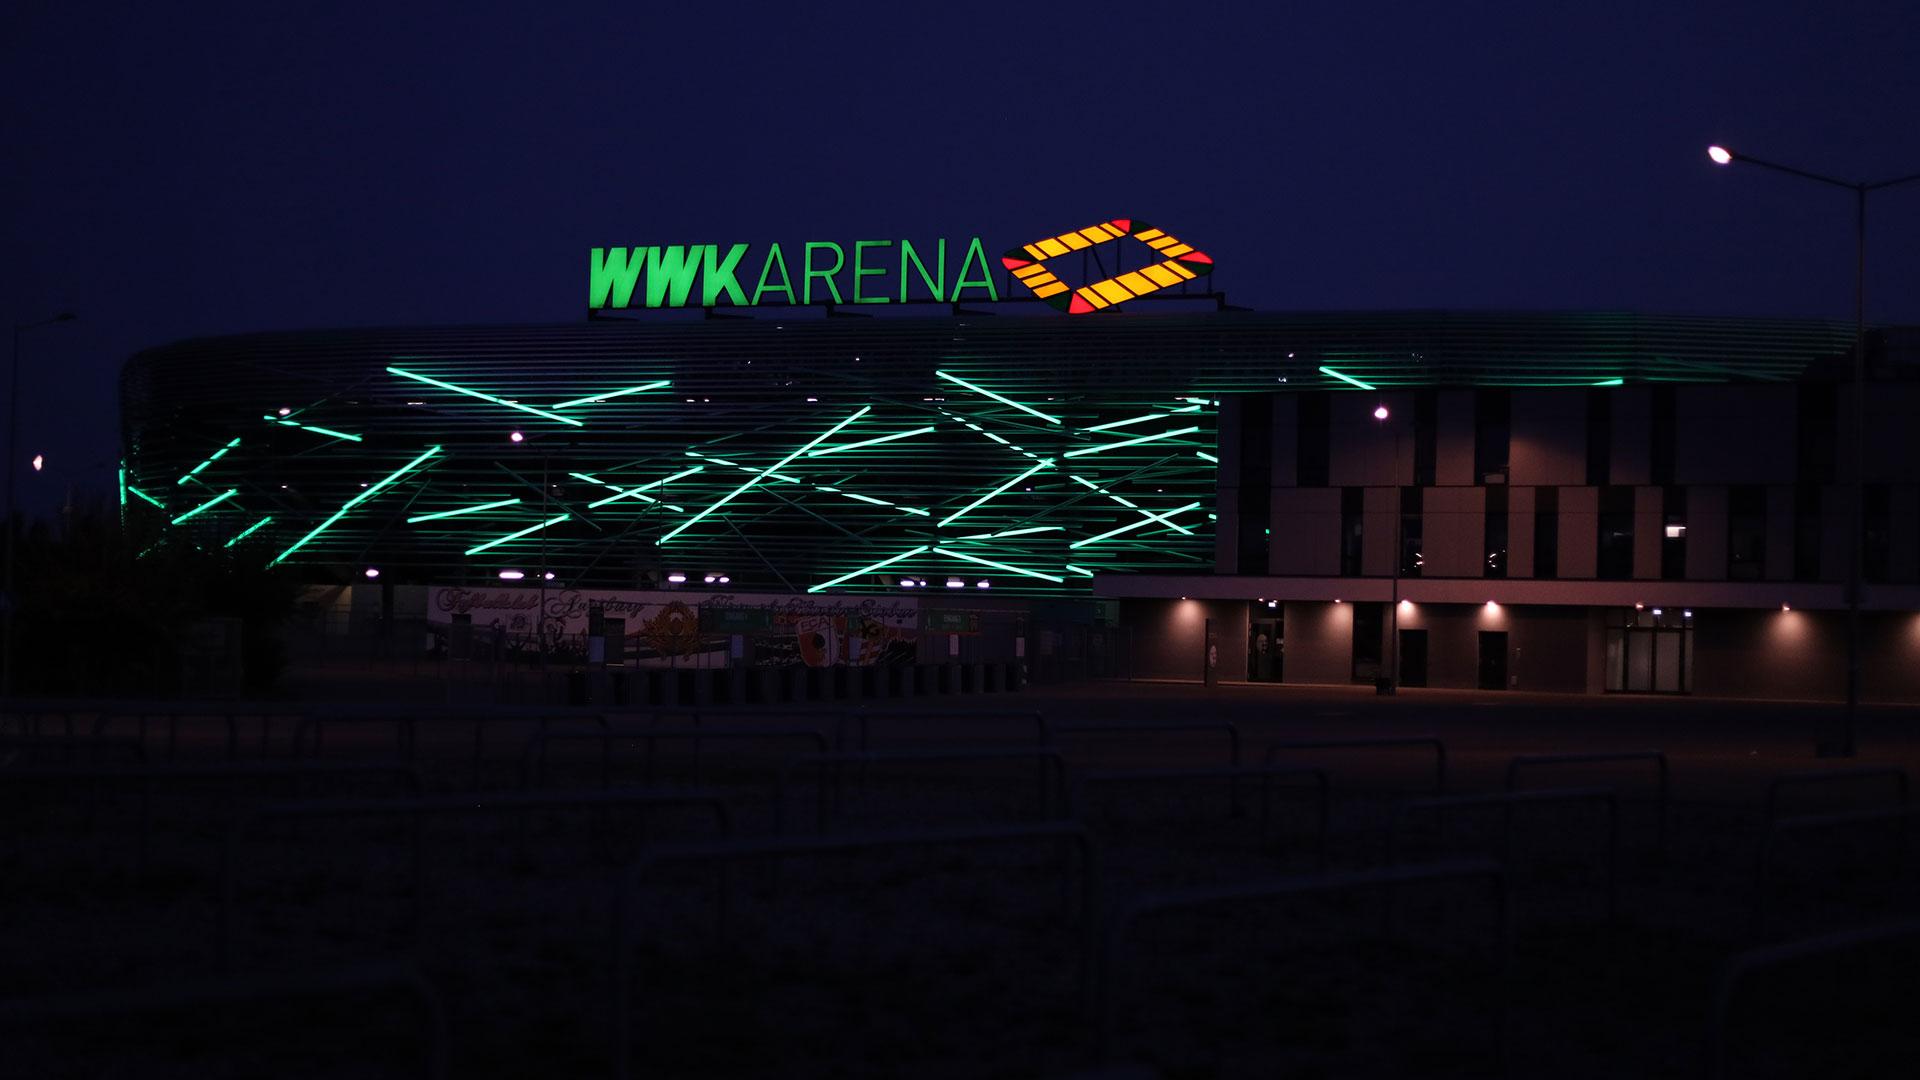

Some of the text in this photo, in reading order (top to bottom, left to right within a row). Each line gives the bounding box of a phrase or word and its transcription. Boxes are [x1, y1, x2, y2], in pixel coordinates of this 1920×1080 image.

[589, 236, 998, 308] WWK ARENA
[800, 616, 829, 628] FCA
